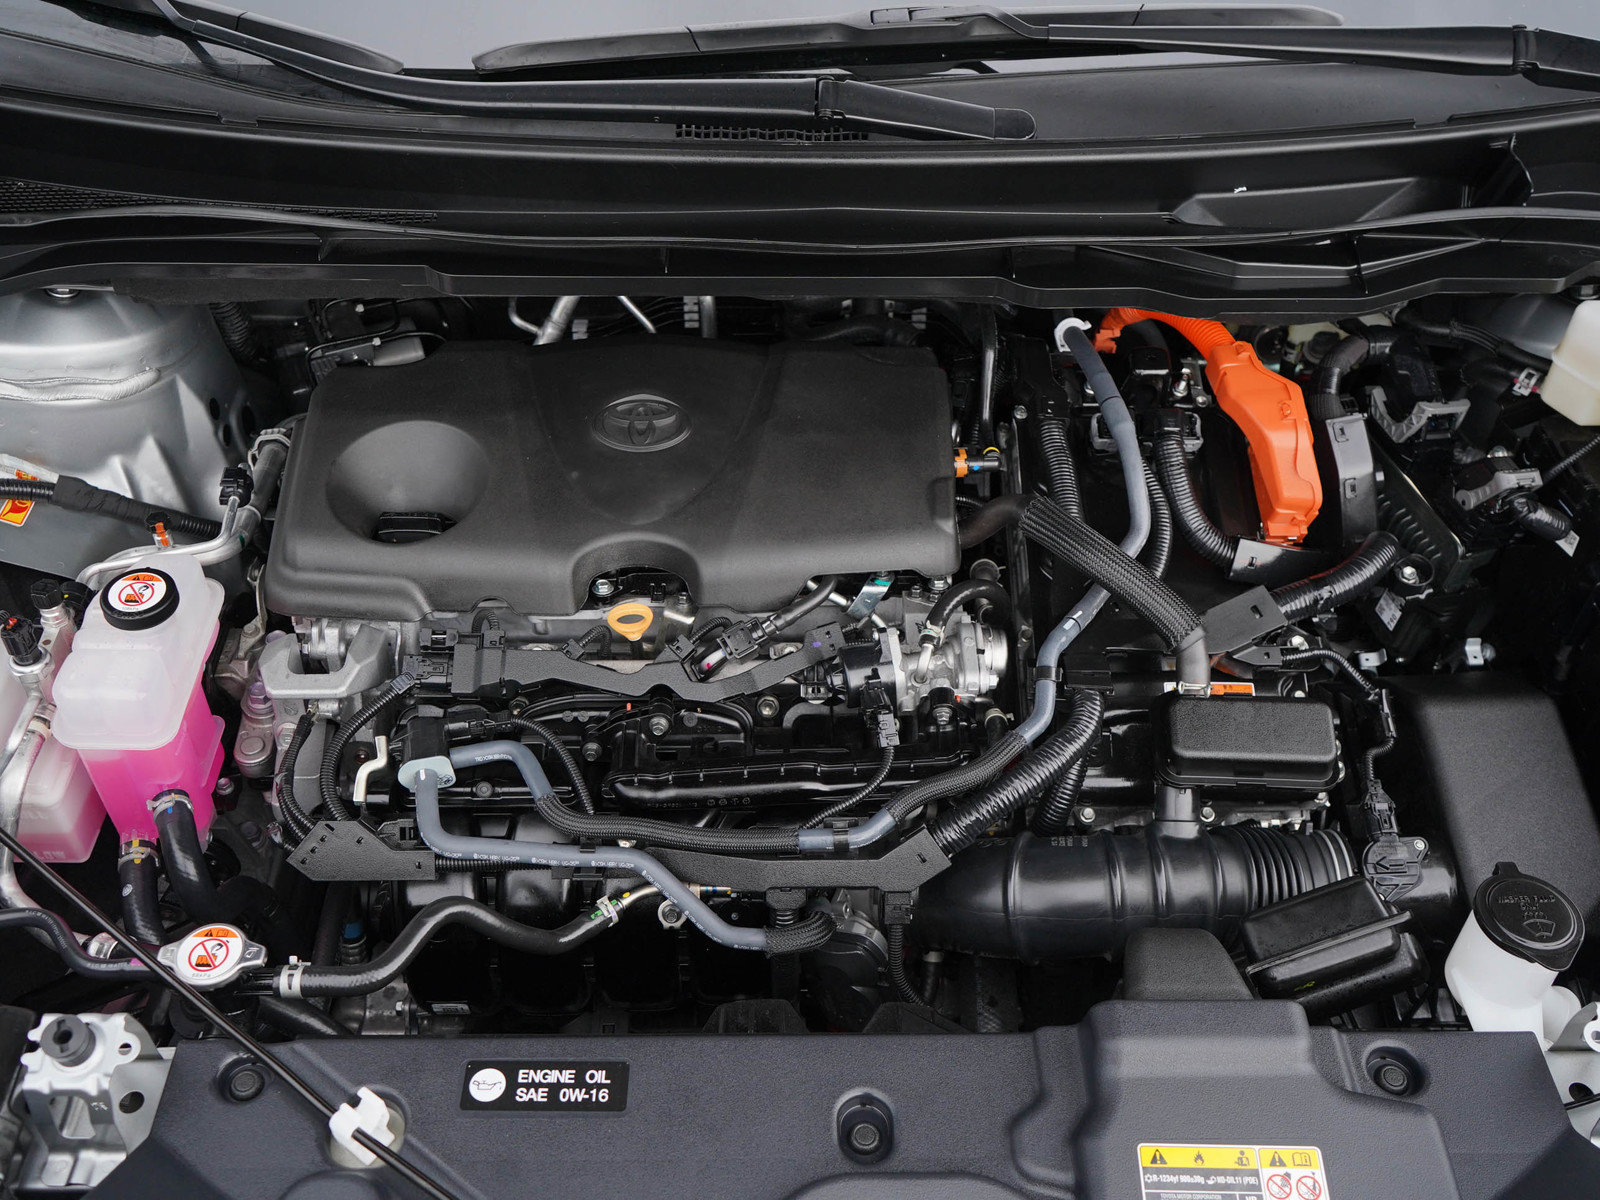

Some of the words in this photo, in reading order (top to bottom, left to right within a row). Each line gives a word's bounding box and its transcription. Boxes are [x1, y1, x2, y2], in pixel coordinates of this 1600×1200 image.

[517, 1069, 576, 1084] ENGINE
[585, 1069, 611, 1084] OIL
[515, 1087, 549, 1102] SAE
[559, 1088, 609, 1102] 0W-16
